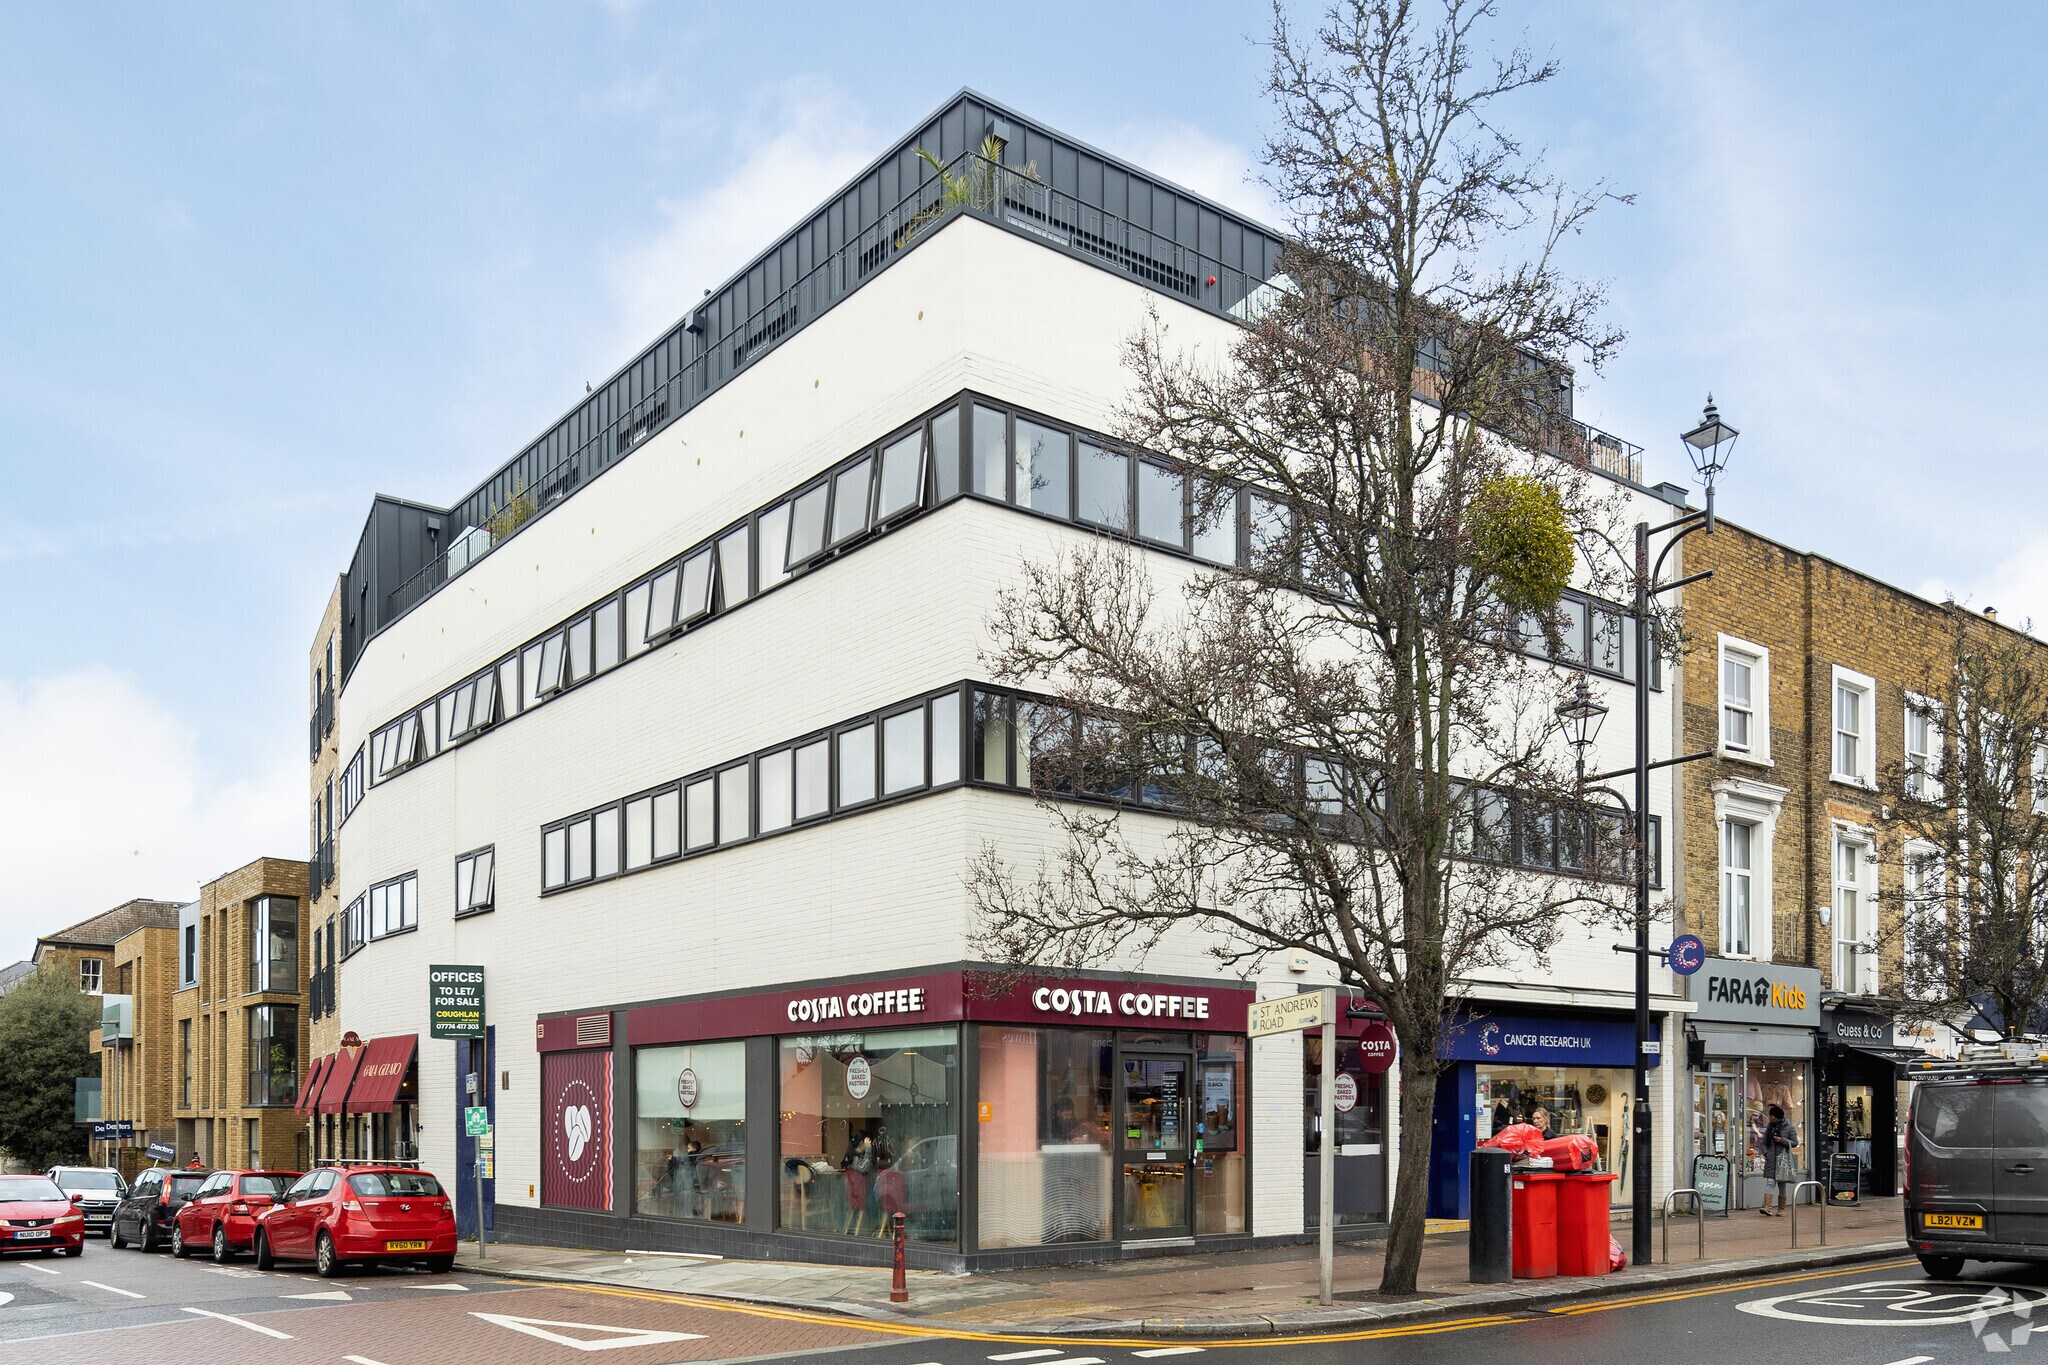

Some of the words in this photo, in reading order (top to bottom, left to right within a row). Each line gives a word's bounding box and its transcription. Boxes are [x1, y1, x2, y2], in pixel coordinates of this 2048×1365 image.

[431, 972, 483, 983] OFFICES
[439, 987, 453, 995] TO
[455, 987, 475, 996] LET/
[1708, 976, 1753, 1004] FARA
[1771, 981, 1807, 1010] Kids
[435, 997, 455, 1006] FOR
[456, 998, 480, 1006] SALE
[787, 996, 845, 1024] COSTA
[846, 988, 925, 1017] COFFEE
[1032, 987, 1113, 1017] COSTA
[1118, 992, 1209, 1019] COFFEE
[1260, 1005, 1271, 1018] ST
[1274, 996, 1319, 1015] ANDREWS
[1260, 1017, 1284, 1031] ROAD
[1837, 1022, 1861, 1038] Guess
[1863, 1024, 1870, 1038] &
[1870, 1024, 1883, 1039] Co
[1361, 1040, 1391, 1051] COSTA
[1503, 1033, 1537, 1047] CANCER
[1539, 1035, 1579, 1048] RESEARCH
[1580, 1037, 1591, 1049] UK
[363, 1064, 378, 1077] GALA
[378, 1062, 402, 1076] GELATO
[150, 1143, 174, 1155] Dexters
[1699, 1163, 1718, 1171] FARA
[1702, 1170, 1719, 1178] Kids
[1698, 1181, 1724, 1190] open
[1930, 1215, 1953, 1226] LB21
[1955, 1217, 1976, 1226] VZW
[390, 1241, 408, 1249] RV60
